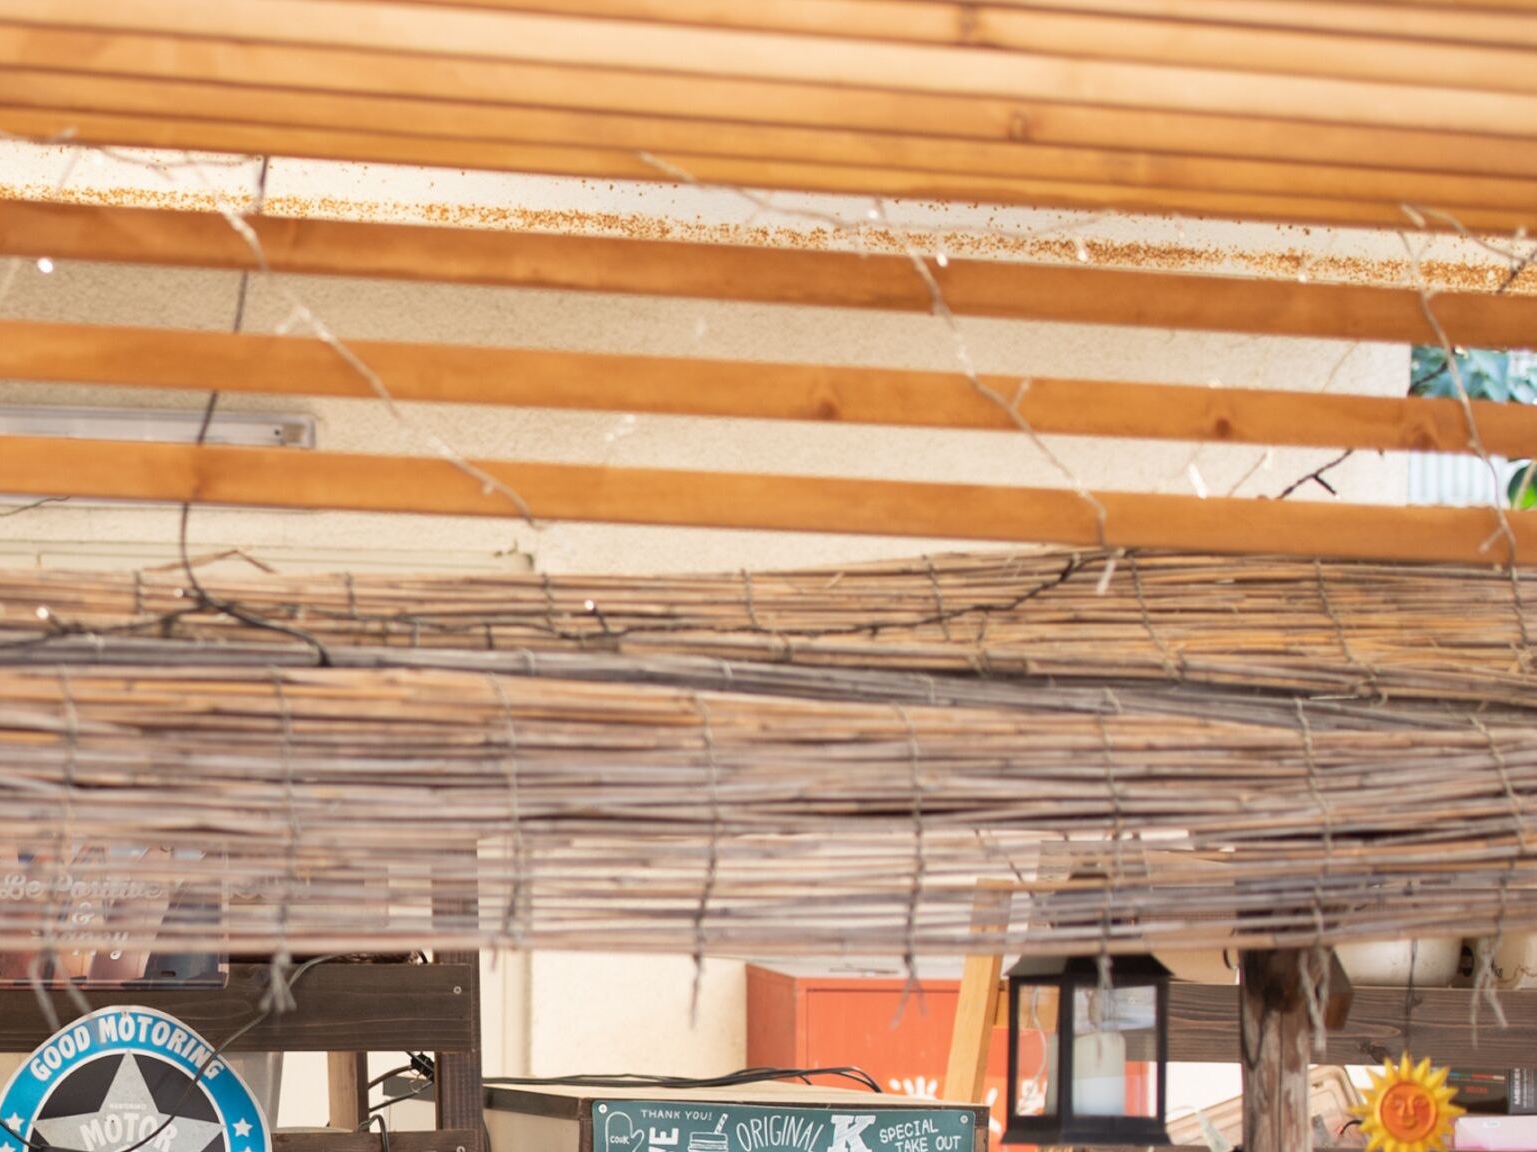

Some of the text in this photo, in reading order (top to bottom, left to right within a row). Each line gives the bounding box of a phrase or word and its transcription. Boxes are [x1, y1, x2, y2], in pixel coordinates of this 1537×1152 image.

[30, 1013, 225, 1082] GOOD MOTORING
[640, 1109, 713, 1121] THANK YOU!
[879, 1119, 939, 1144] SPECIAL
[935, 1135, 962, 1151] OUT
